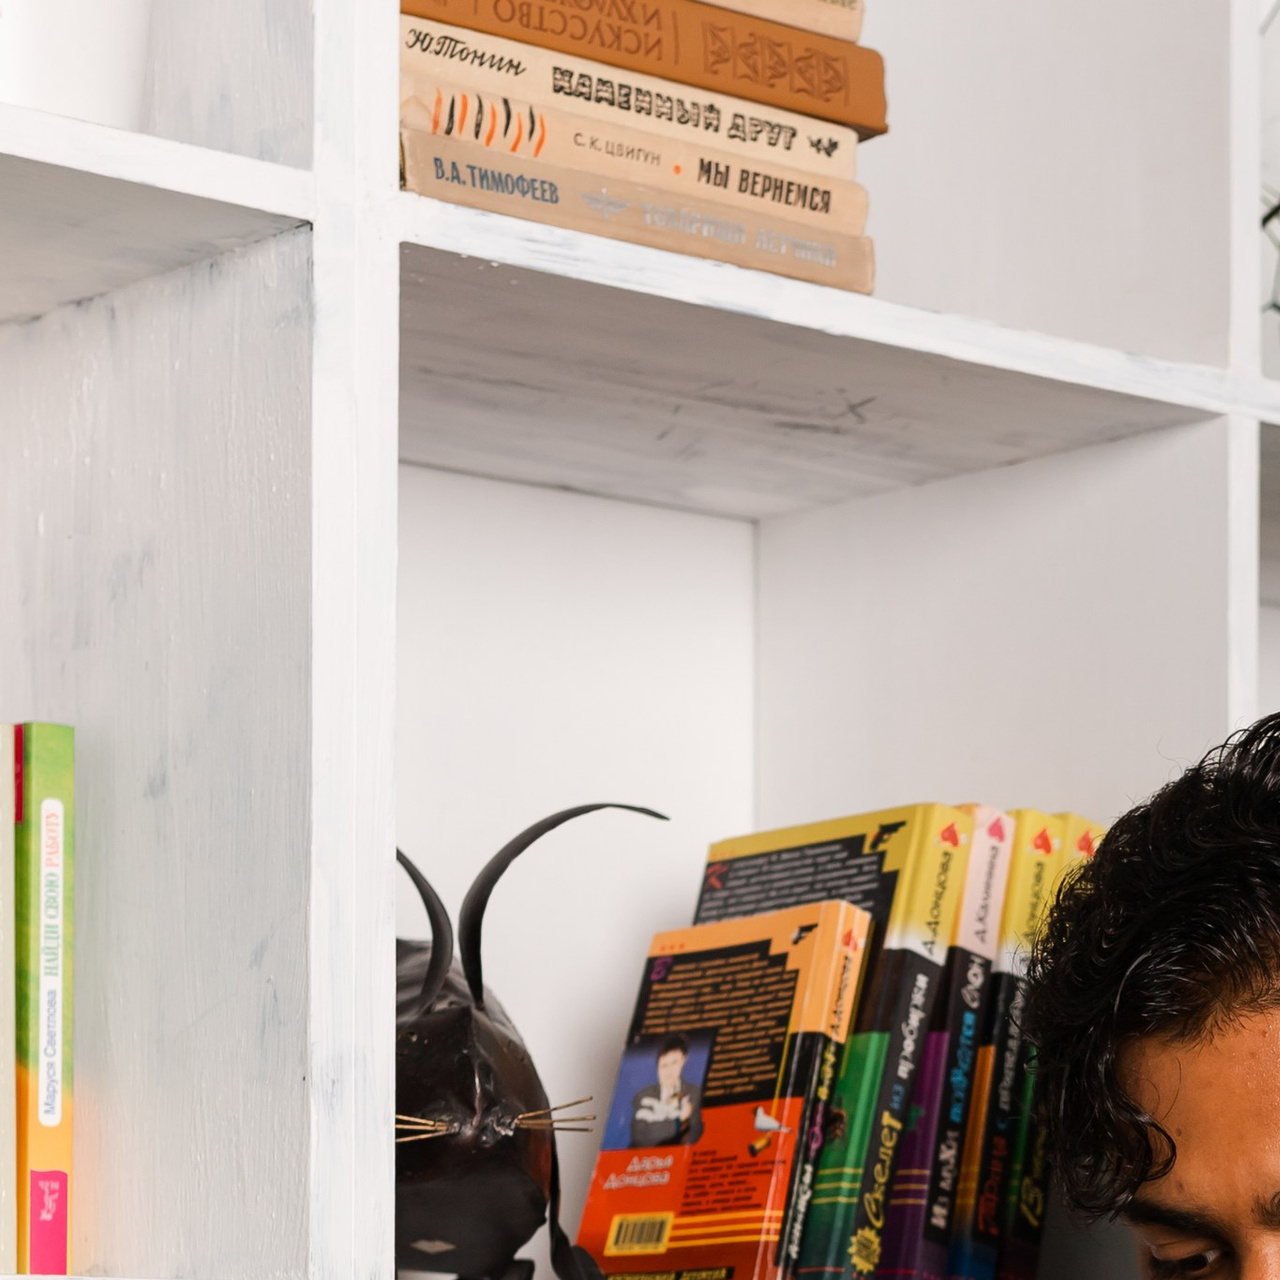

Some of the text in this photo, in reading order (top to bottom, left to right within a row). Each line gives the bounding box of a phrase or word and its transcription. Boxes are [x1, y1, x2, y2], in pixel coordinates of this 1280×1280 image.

[604, 138, 662, 167] ЦВИГУН
[727, 111, 798, 152] ДРУГ
[696, 157, 833, 215] МЫ ВЕРНЕМСЯ
[42, 808, 60, 978] НАЙДИ СВОЮ РАБОТУ
[44, 989, 58, 1116] Маруся Светлова
[864, 1110, 904, 1229] Скелет
